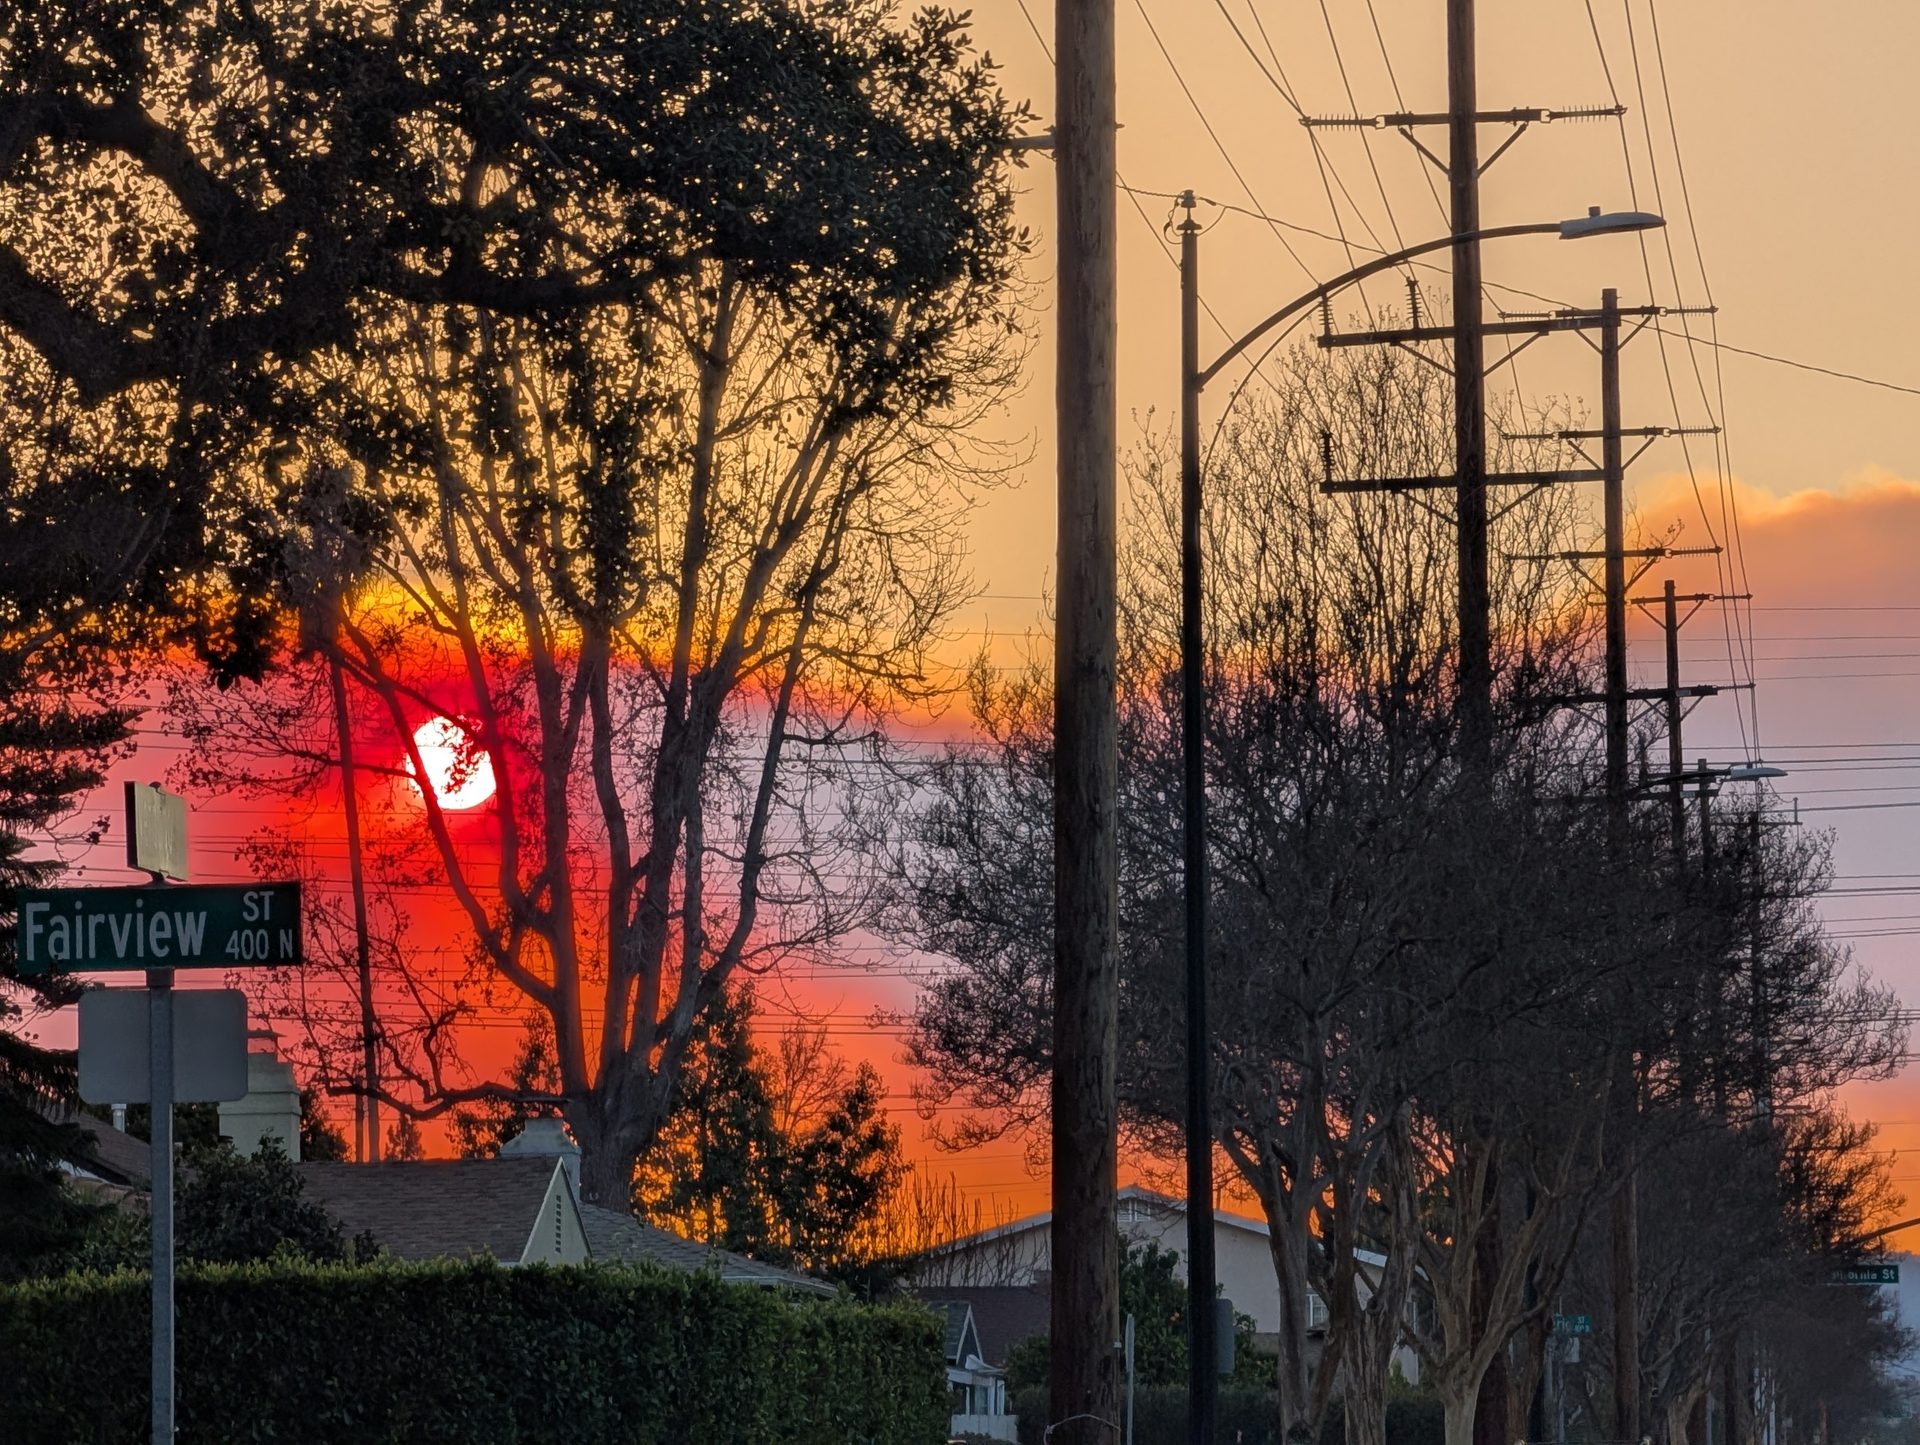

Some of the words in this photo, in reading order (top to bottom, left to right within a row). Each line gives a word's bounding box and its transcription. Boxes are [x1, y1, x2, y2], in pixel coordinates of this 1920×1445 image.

[242, 890, 275, 922] ST
[25, 898, 208, 962] Fairview
[225, 929, 269, 960] 400
[279, 928, 293, 959] N
[1881, 1268, 1895, 1280] St
